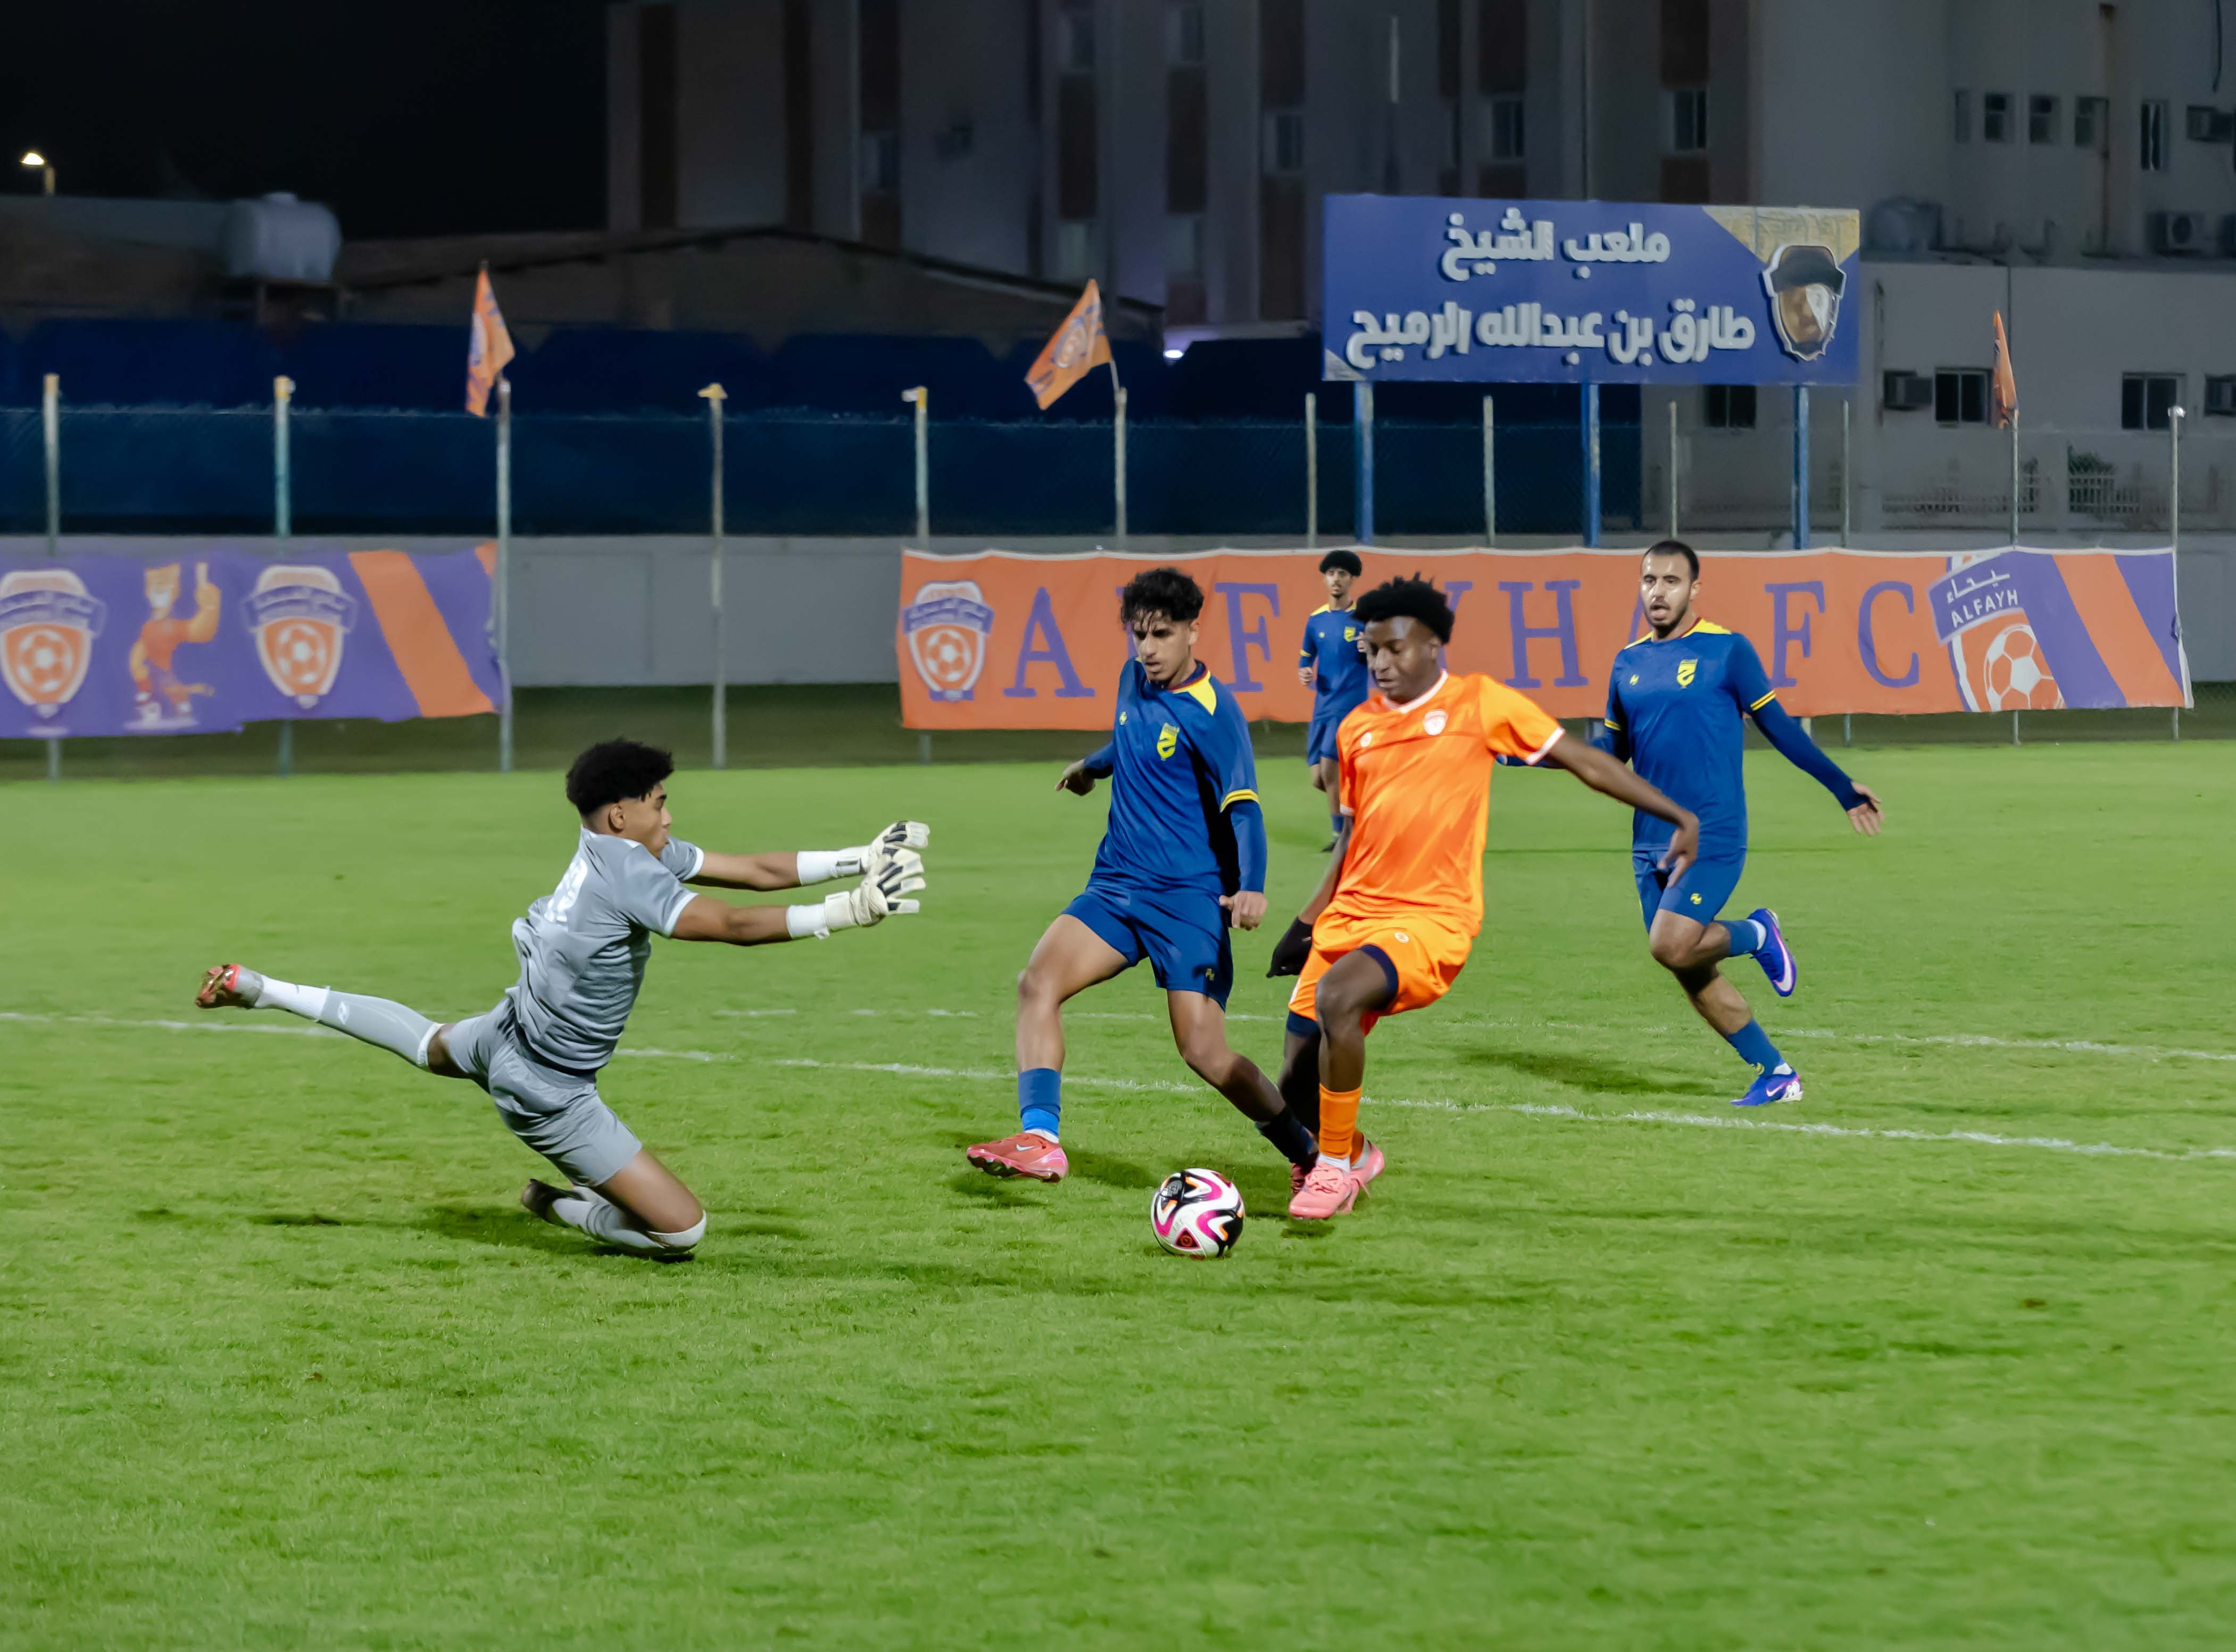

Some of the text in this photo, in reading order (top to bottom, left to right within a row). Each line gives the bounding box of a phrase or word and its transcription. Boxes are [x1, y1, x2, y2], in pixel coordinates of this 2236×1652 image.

[1441, 206, 1672, 282] ملعب الشيخ
[1344, 298, 1757, 370] طارق بن عبدالله الرميح
